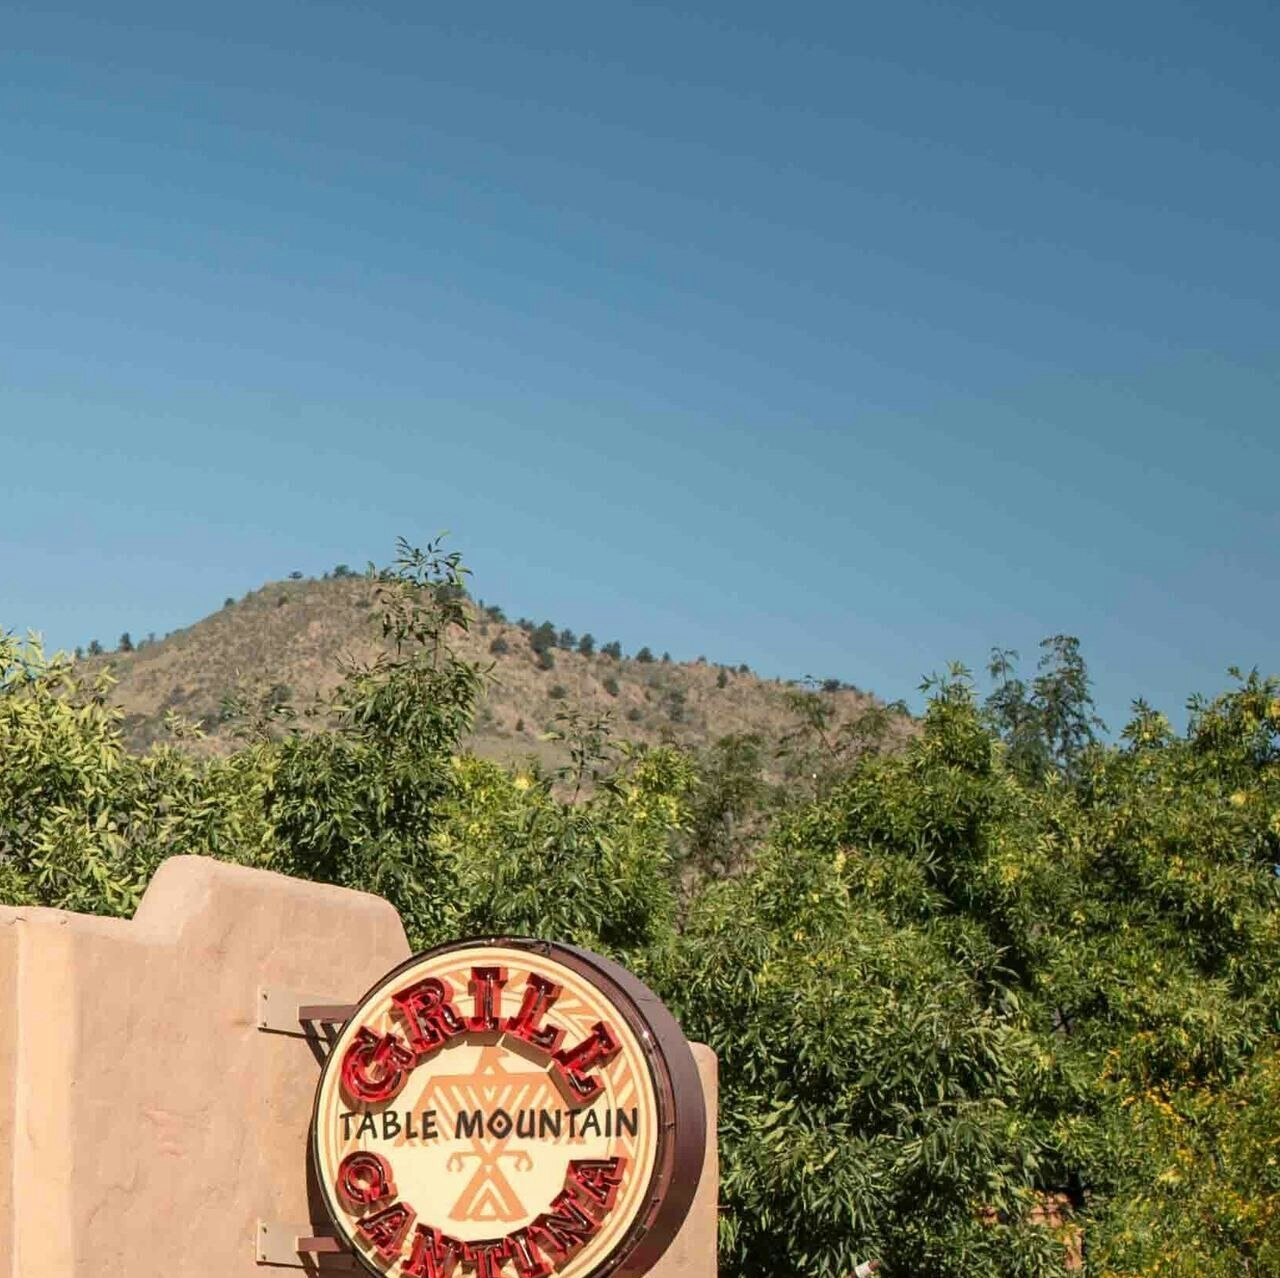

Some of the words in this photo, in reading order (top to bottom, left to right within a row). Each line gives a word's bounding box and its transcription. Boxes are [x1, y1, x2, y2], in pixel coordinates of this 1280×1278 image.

[341, 965, 622, 1102] GRILL
[340, 1109, 438, 1141] TABLE
[454, 1107, 639, 1140] MOUNTAIN
